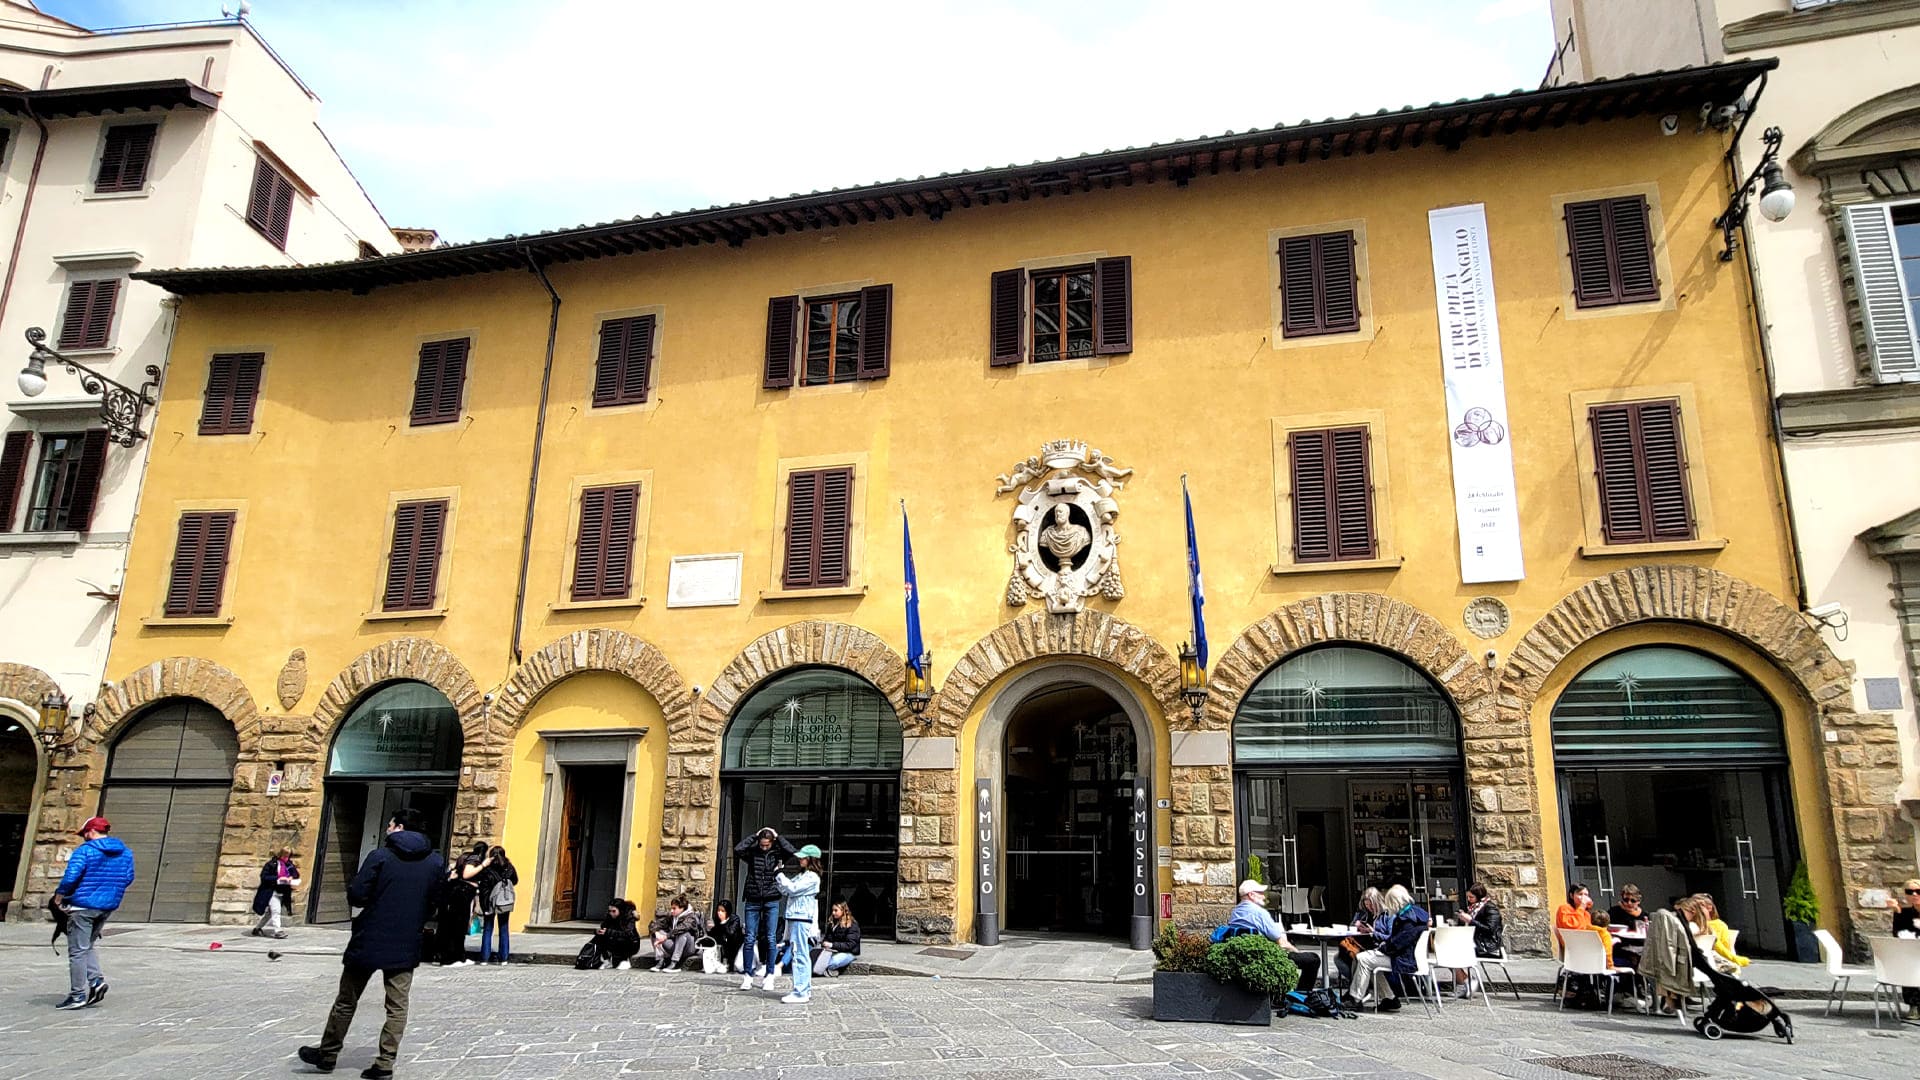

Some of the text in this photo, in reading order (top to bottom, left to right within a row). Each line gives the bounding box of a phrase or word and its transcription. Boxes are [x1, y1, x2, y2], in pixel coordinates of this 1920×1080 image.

[1455, 228, 1482, 369] DI MICHELANGELO
[1449, 320, 1465, 350] TRE
[1454, 352, 1467, 369] LE
[801, 714, 837, 724] MUSEO
[802, 733, 842, 743] DUOMO
[979, 811, 993, 894] MUSEO
[1134, 811, 1146, 896] MUSEO
